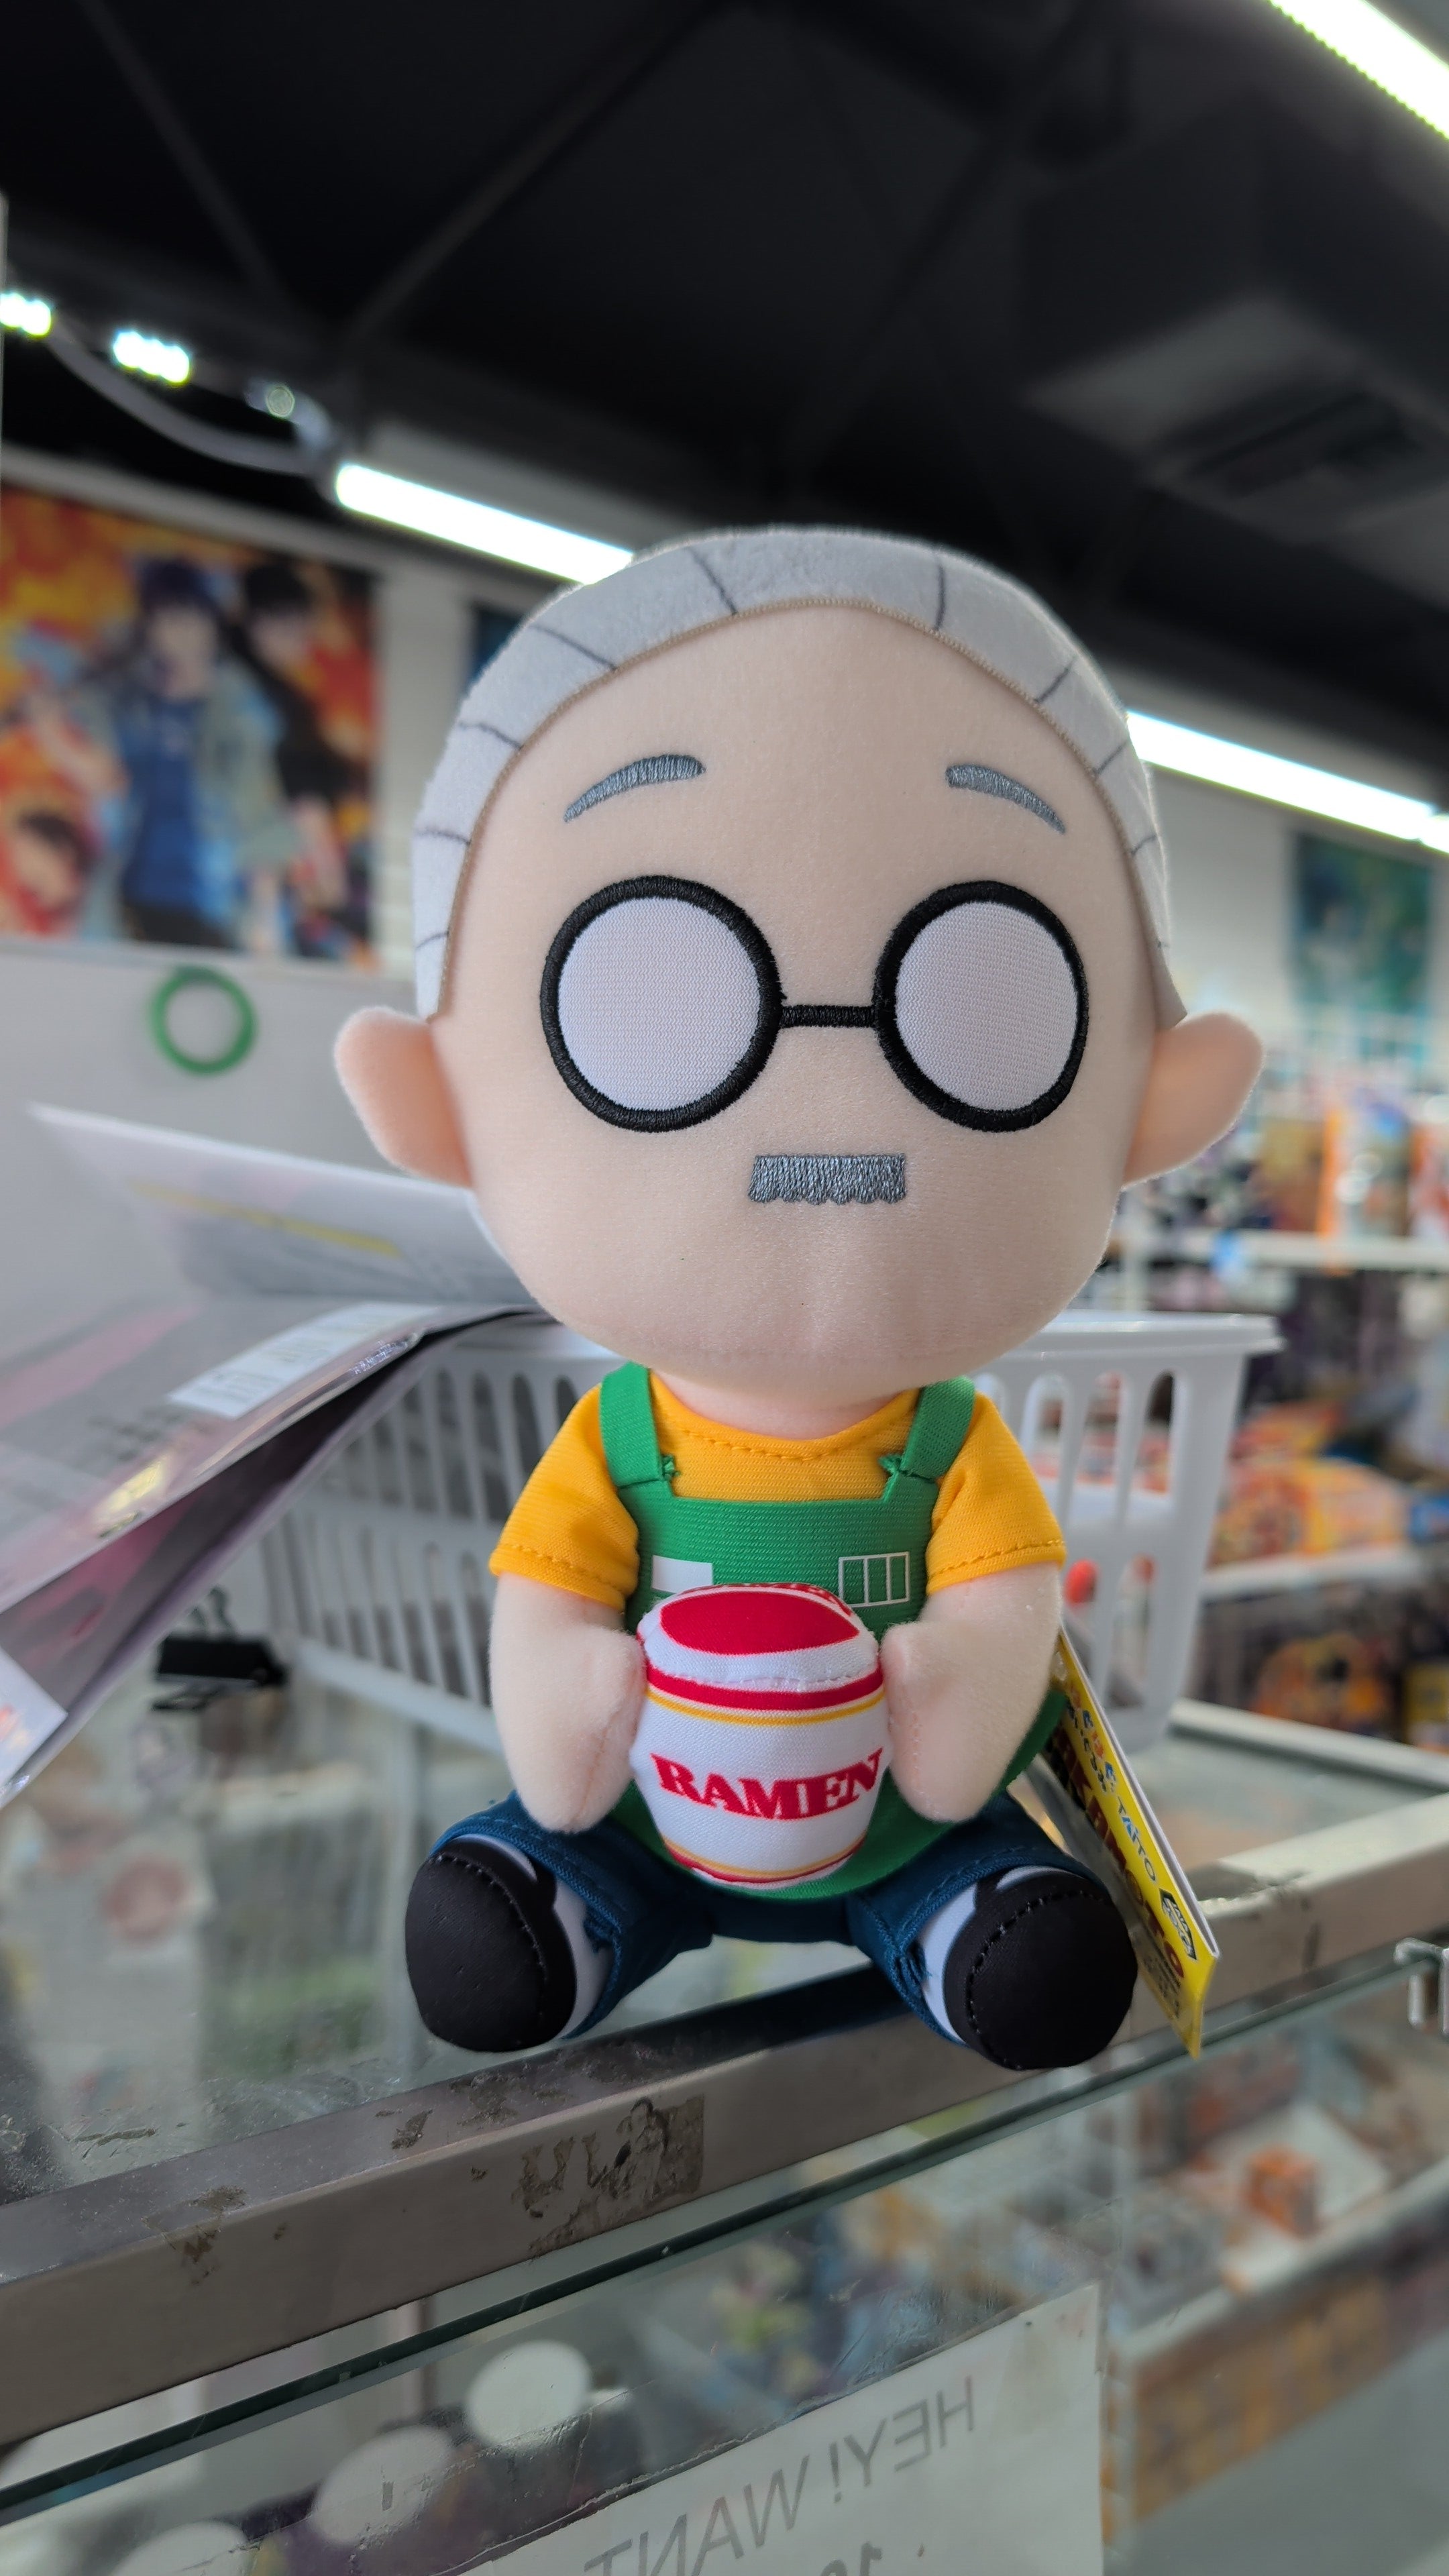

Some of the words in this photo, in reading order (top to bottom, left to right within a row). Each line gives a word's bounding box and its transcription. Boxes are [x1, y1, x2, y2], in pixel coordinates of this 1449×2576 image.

[651, 1747, 883, 1821] RAMEN
[1054, 1725, 1185, 1978] AKAMOTO
[1118, 1796, 1157, 1881] TAITO
